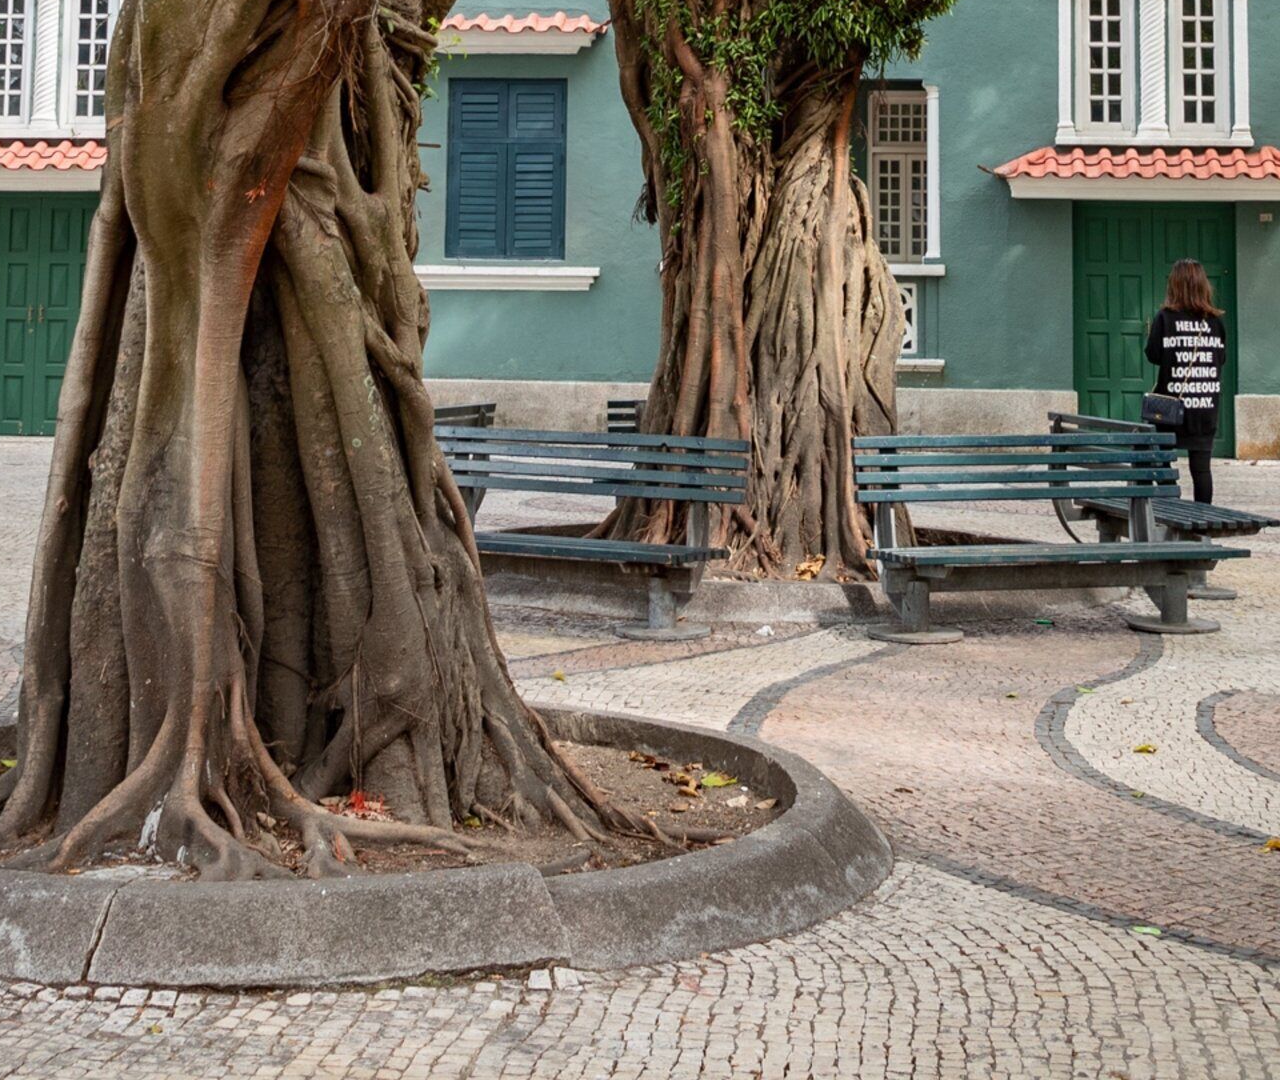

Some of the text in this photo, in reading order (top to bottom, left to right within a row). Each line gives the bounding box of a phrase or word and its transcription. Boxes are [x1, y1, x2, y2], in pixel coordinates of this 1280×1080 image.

[1175, 320, 1211, 333] HELLO,
[1175, 351, 1213, 363] YOU'RE
[1171, 367, 1217, 378] LOOKING
[1167, 382, 1221, 393] GORGEOUS
[1182, 397, 1214, 408] ODAY.
